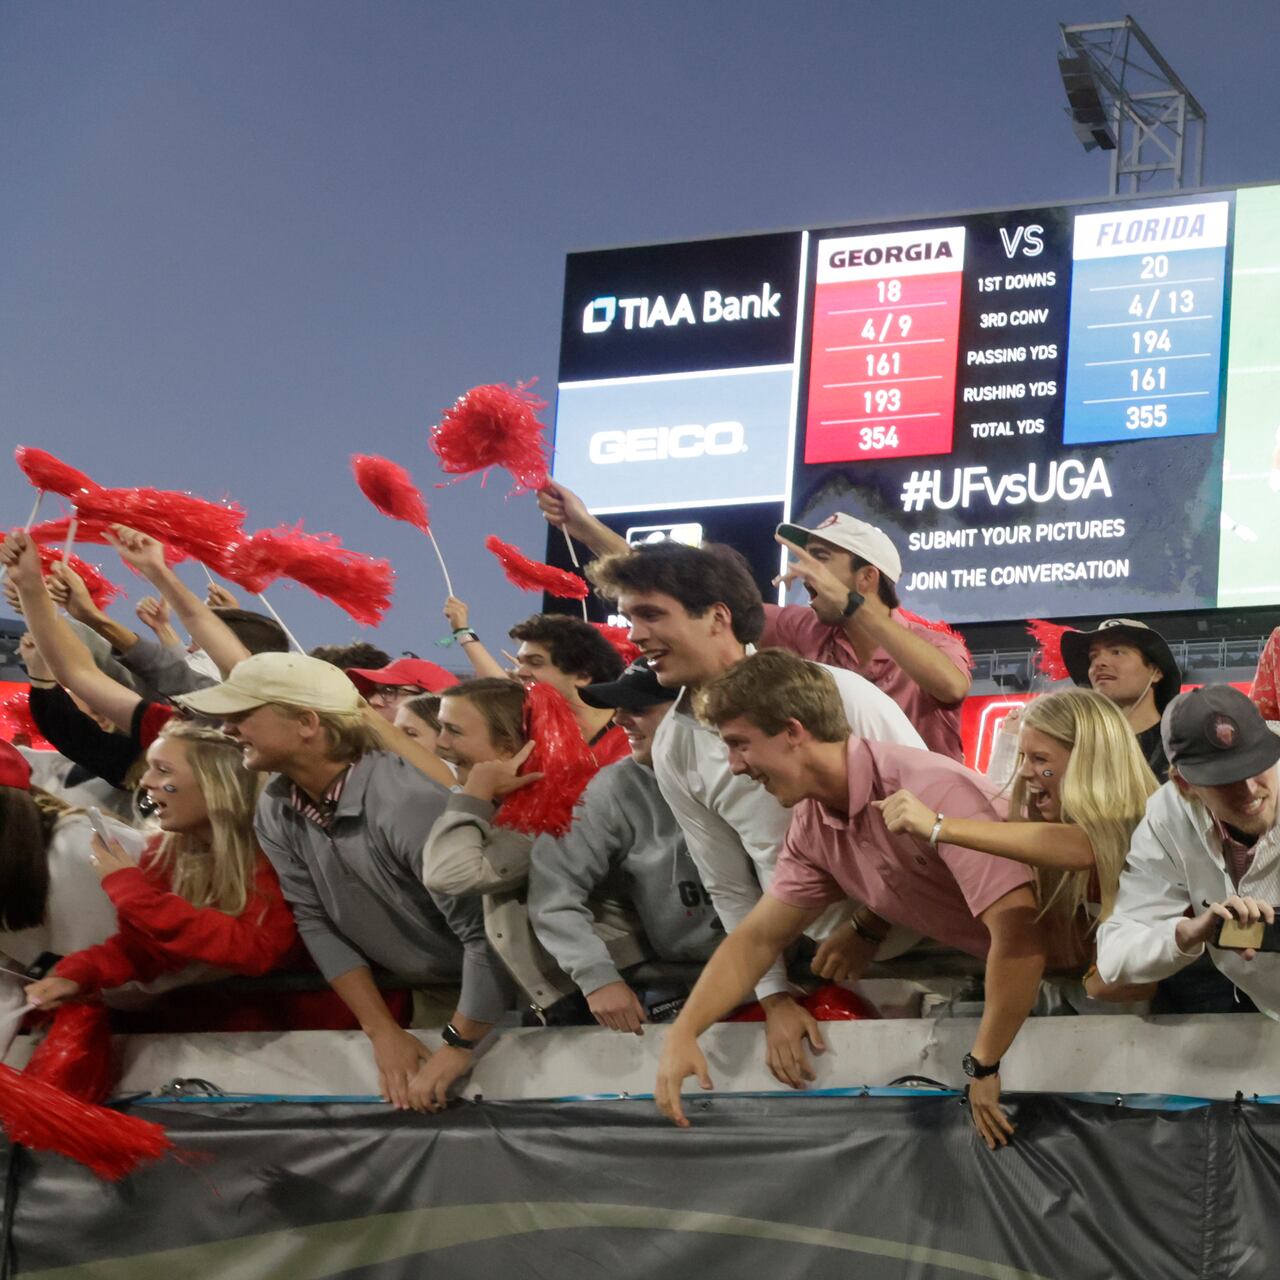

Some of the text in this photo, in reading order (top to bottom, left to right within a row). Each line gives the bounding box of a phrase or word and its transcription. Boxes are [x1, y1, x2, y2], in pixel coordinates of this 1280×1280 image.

[1000, 225, 1044, 258] VS
[1096, 214, 1206, 247] FLORIDA
[829, 241, 953, 269] GEORGIA
[1140, 255, 1168, 279] 20
[876, 279, 902, 303] 18
[977, 271, 1056, 292] 1ST DOWNS
[618, 282, 782, 330] TIAA Bank
[979, 308, 1049, 329] 3RD CONV
[1132, 329, 1171, 354] 194
[866, 352, 900, 377] 161
[966, 344, 1058, 366] PASSING YDS
[963, 380, 1057, 403] RUSHING YDS
[1130, 366, 1167, 392] 161
[863, 388, 901, 414] 193
[970, 418, 1045, 439] TOTAL YDS
[1126, 404, 1167, 430] 355
[589, 421, 744, 465] GEICO
[858, 425, 899, 452] 354
[900, 457, 1113, 512] #UFvsUGA
[908, 518, 1126, 551] SUBMIT YOUR PICTURES
[905, 558, 1130, 592] JOIN THE CONVERSATION
